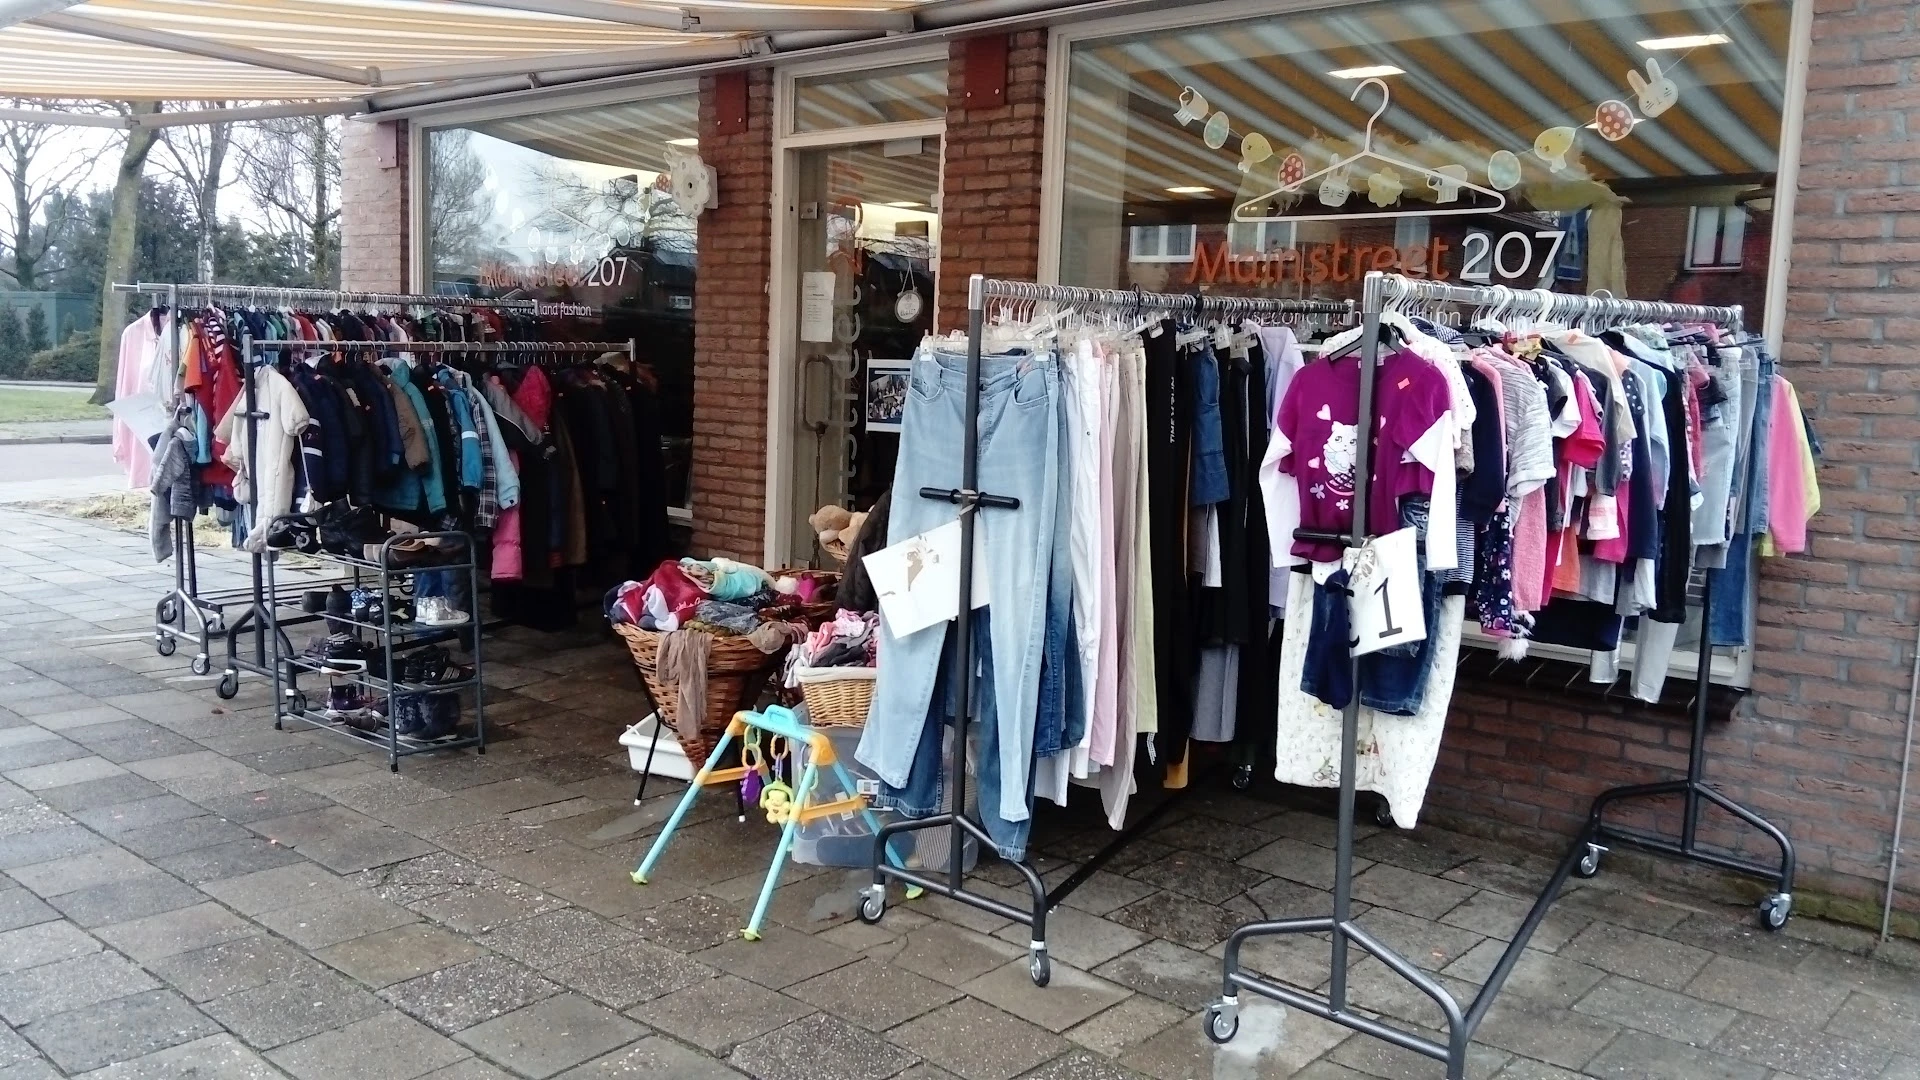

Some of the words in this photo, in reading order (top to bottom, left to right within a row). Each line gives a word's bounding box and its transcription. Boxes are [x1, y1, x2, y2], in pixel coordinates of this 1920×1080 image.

[587, 256, 628, 287] 207
[1185, 236, 1450, 285] Mainstreet
[1460, 230, 1567, 280] 207
[560, 301, 592, 319] fashion
